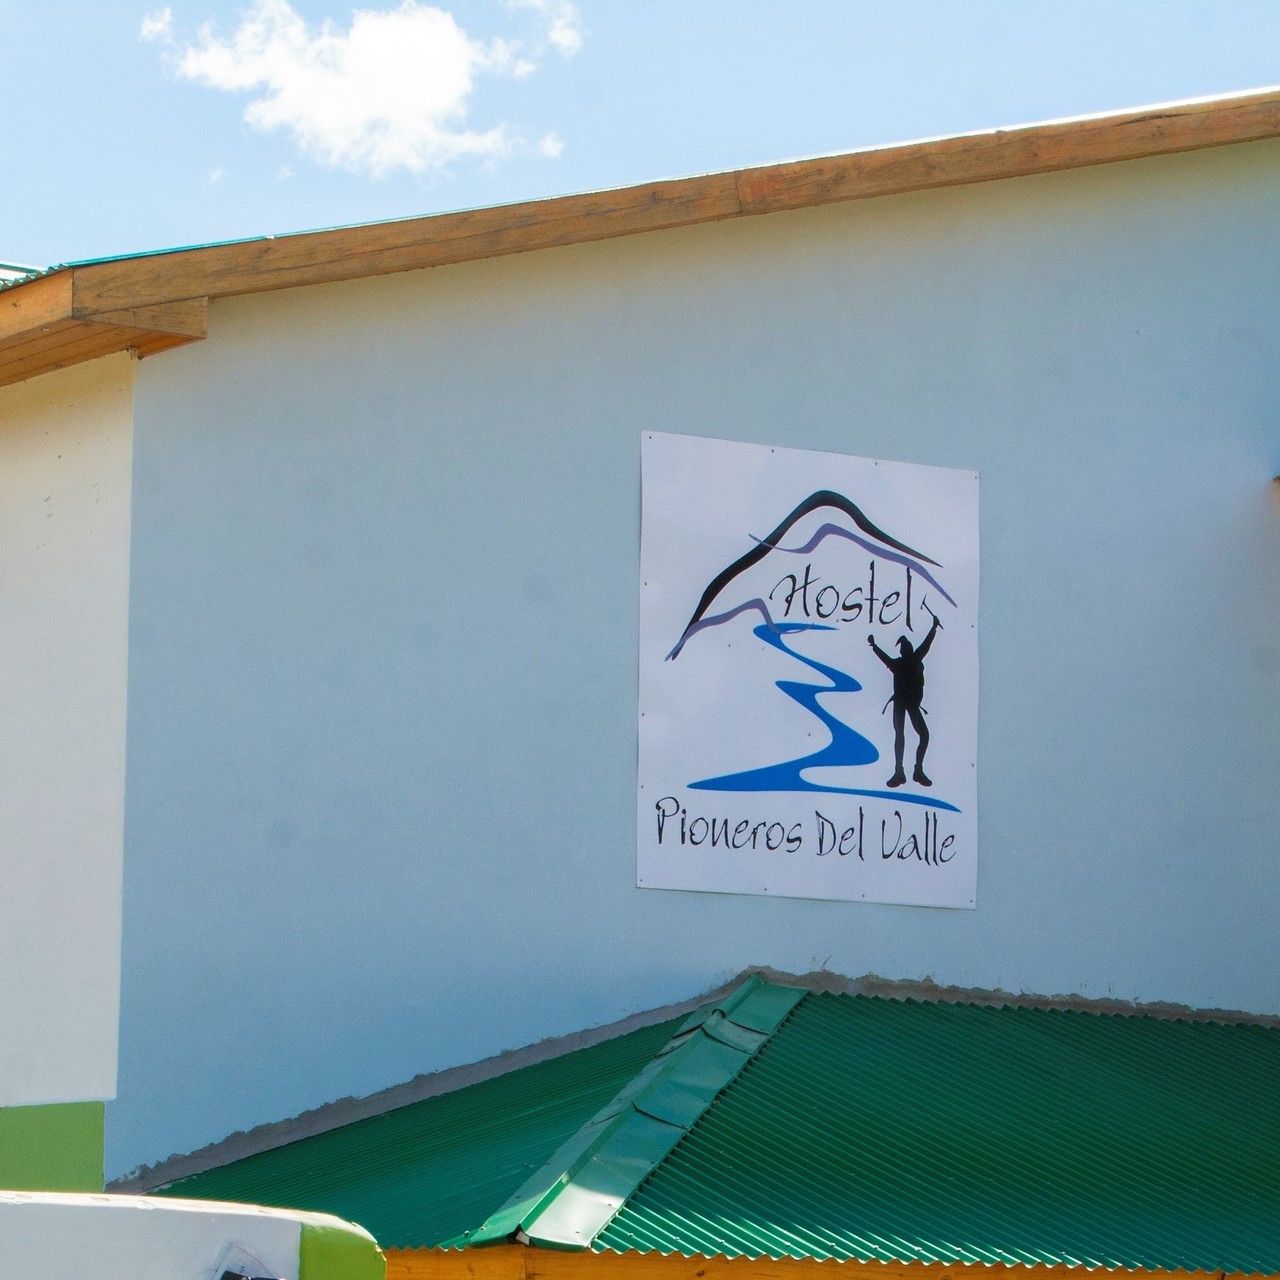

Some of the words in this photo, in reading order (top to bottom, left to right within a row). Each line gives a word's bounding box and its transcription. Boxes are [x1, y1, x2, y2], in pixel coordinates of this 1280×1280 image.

[769, 559, 913, 632] Hostel
[655, 796, 803, 854] Pioneros
[815, 806, 864, 862] Del
[881, 810, 957, 867] Valle
